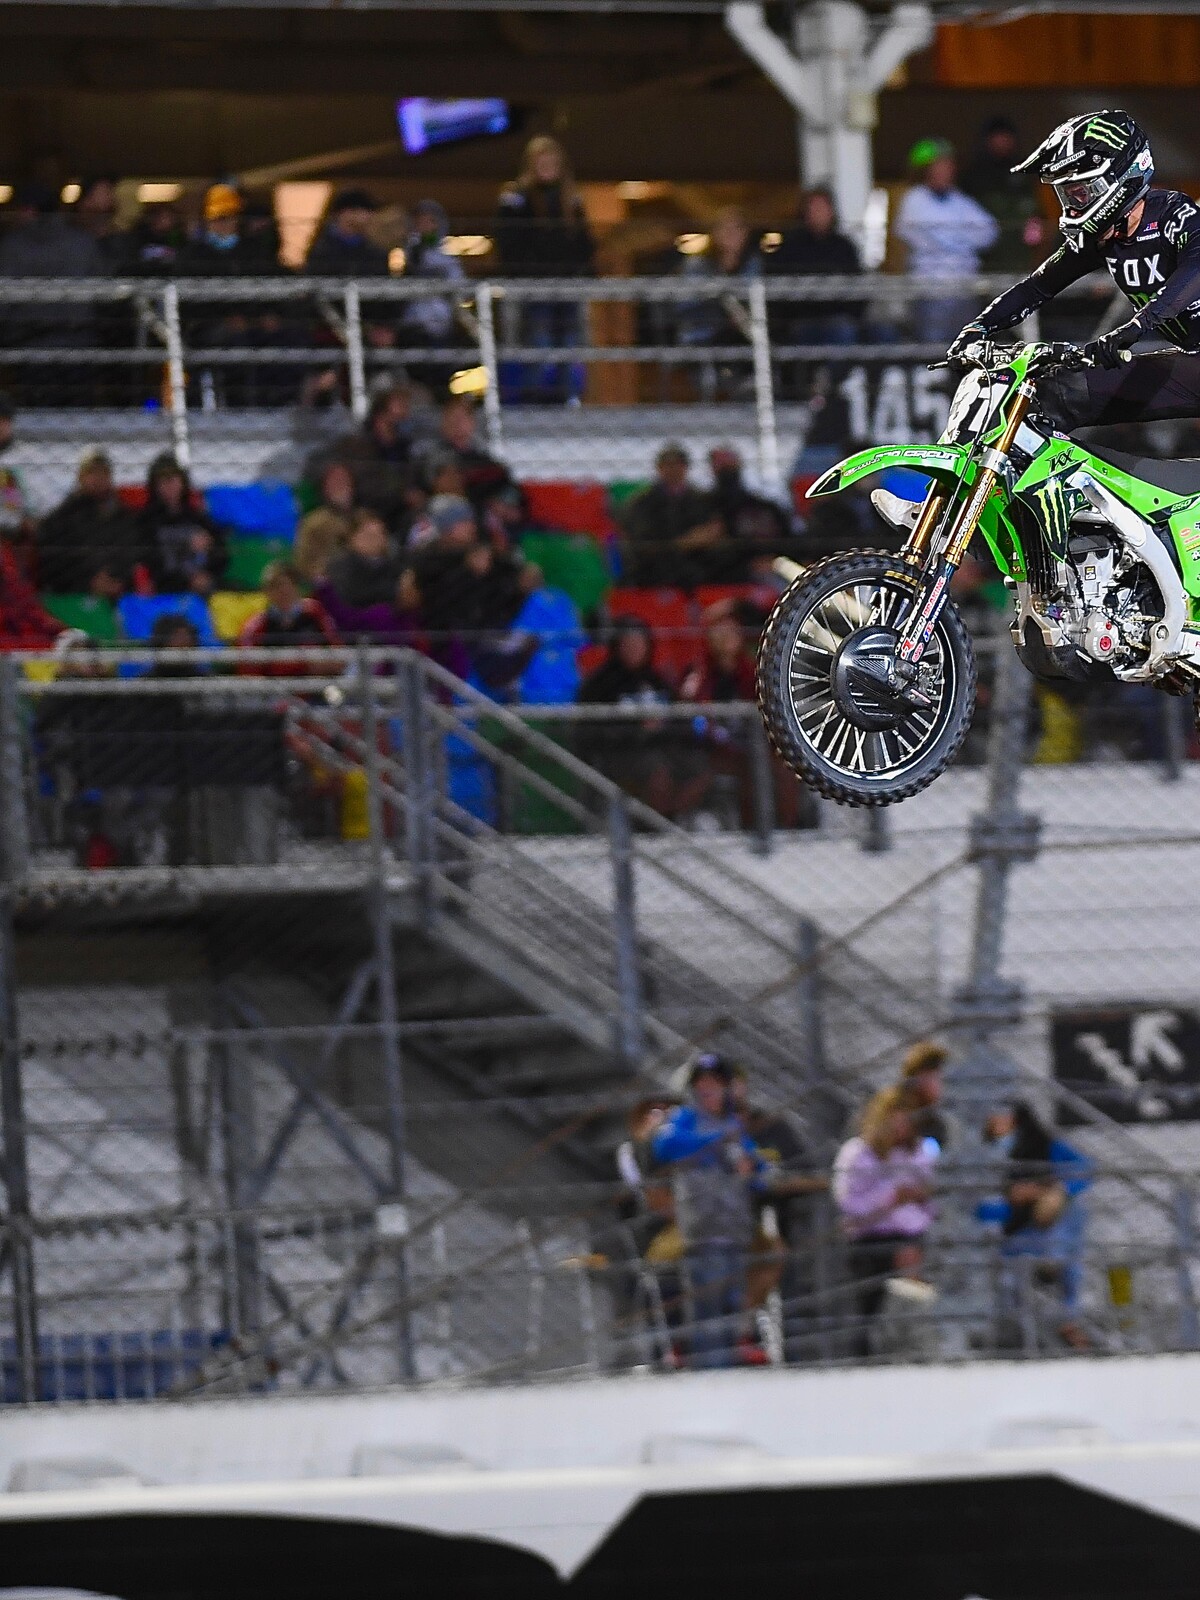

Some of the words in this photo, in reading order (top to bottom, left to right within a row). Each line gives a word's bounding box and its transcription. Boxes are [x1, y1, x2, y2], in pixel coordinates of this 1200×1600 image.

[1093, 186, 1128, 222] MONSTER
[1105, 253, 1165, 287] FOX
[903, 449, 960, 460] CIRCUIT
